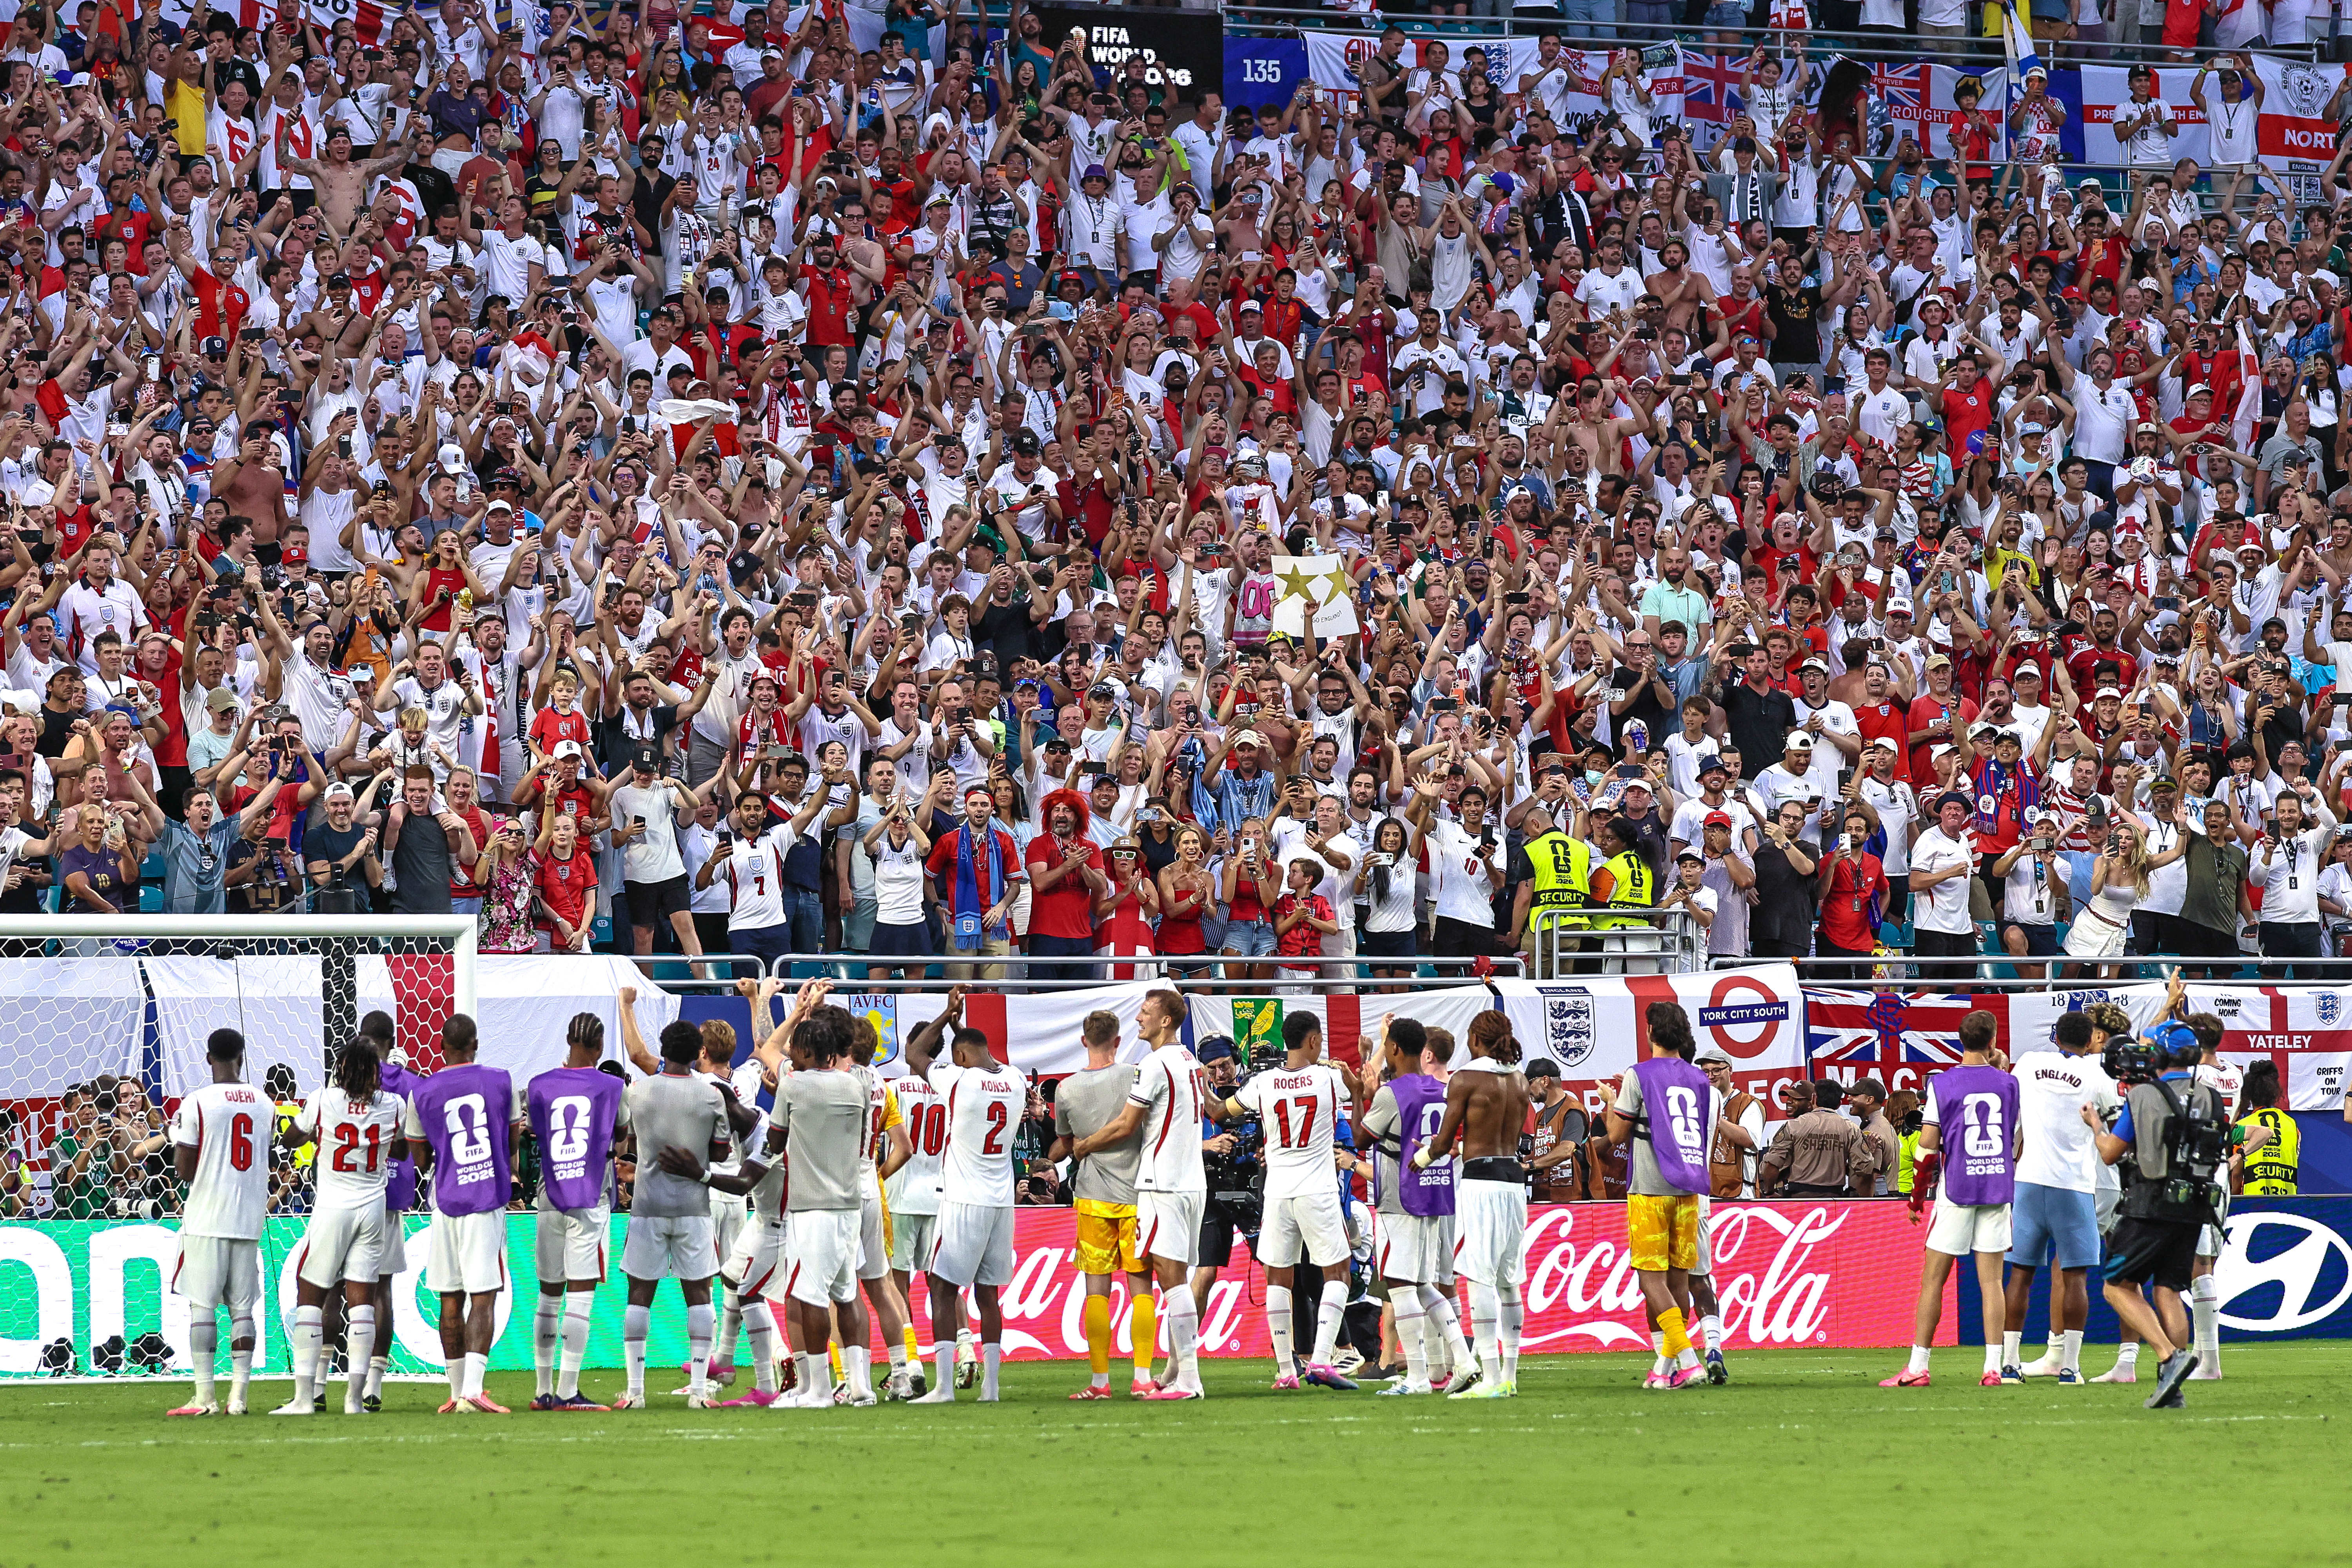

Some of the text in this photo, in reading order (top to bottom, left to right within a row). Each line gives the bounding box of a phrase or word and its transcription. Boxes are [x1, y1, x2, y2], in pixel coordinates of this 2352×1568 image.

[1092, 26, 1129, 45] FIFA
[1243, 59, 1281, 83] 135
[1874, 77, 1904, 86] FOREVER
[707, 157, 720, 171] 24
[2292, 163, 2317, 172] ENGLAND
[1510, 414, 1543, 427] Carlsberg
[1321, 611, 1342, 622] ENGLAND!
[904, 763, 910, 779] 9
[1464, 857, 1478, 876] 10
[95, 873, 111, 889] 10
[754, 876, 765, 897] 7
[853, 995, 894, 1009] AVFC
[2052, 996, 2066, 1007] 18
[2214, 998, 2241, 1008] COMING
[1702, 1006, 1786, 1021] YORK CITY SOUTH
[2218, 1008, 2239, 1017] HOME
[2247, 1034, 2312, 1049] YATELEY
[2316, 1067, 2344, 1076] GRIFFS
[981, 1079, 1012, 1093] KONSA
[1274, 1075, 1313, 1090] ROGERS
[1826, 1065, 1921, 1101] MAC
[2034, 1070, 2082, 1089] ENGLAND
[2213, 1077, 2239, 1090] STONES
[2325, 1077, 2336, 1086] ON
[225, 1089, 256, 1103] GUÉHI
[2320, 1087, 2341, 1096] TOUR
[910, 1102, 945, 1156] 10
[983, 1101, 1007, 1155] 2
[1273, 1096, 1318, 1149] 17
[231, 1112, 254, 1172] 6
[332, 1122, 380, 1173] 21
[1803, 1140, 1845, 1153] SHERIFF
[1976, 1143, 1993, 1151] FIFA
[465, 1146, 484, 1158] FIFA
[560, 1146, 576, 1156] FIFA
[456, 1163, 483, 1175] WORLD
[572, 1160, 586, 1169] CUP
[1966, 1165, 2005, 1175] 2026
[2253, 1162, 2294, 1180] SECURITY
[457, 1167, 495, 1185] 2026
[1419, 1176, 1450, 1186] 2026
[1603, 1176, 1627, 1185] FIFA.com
[1520, 1207, 1851, 1345] CocaCola
